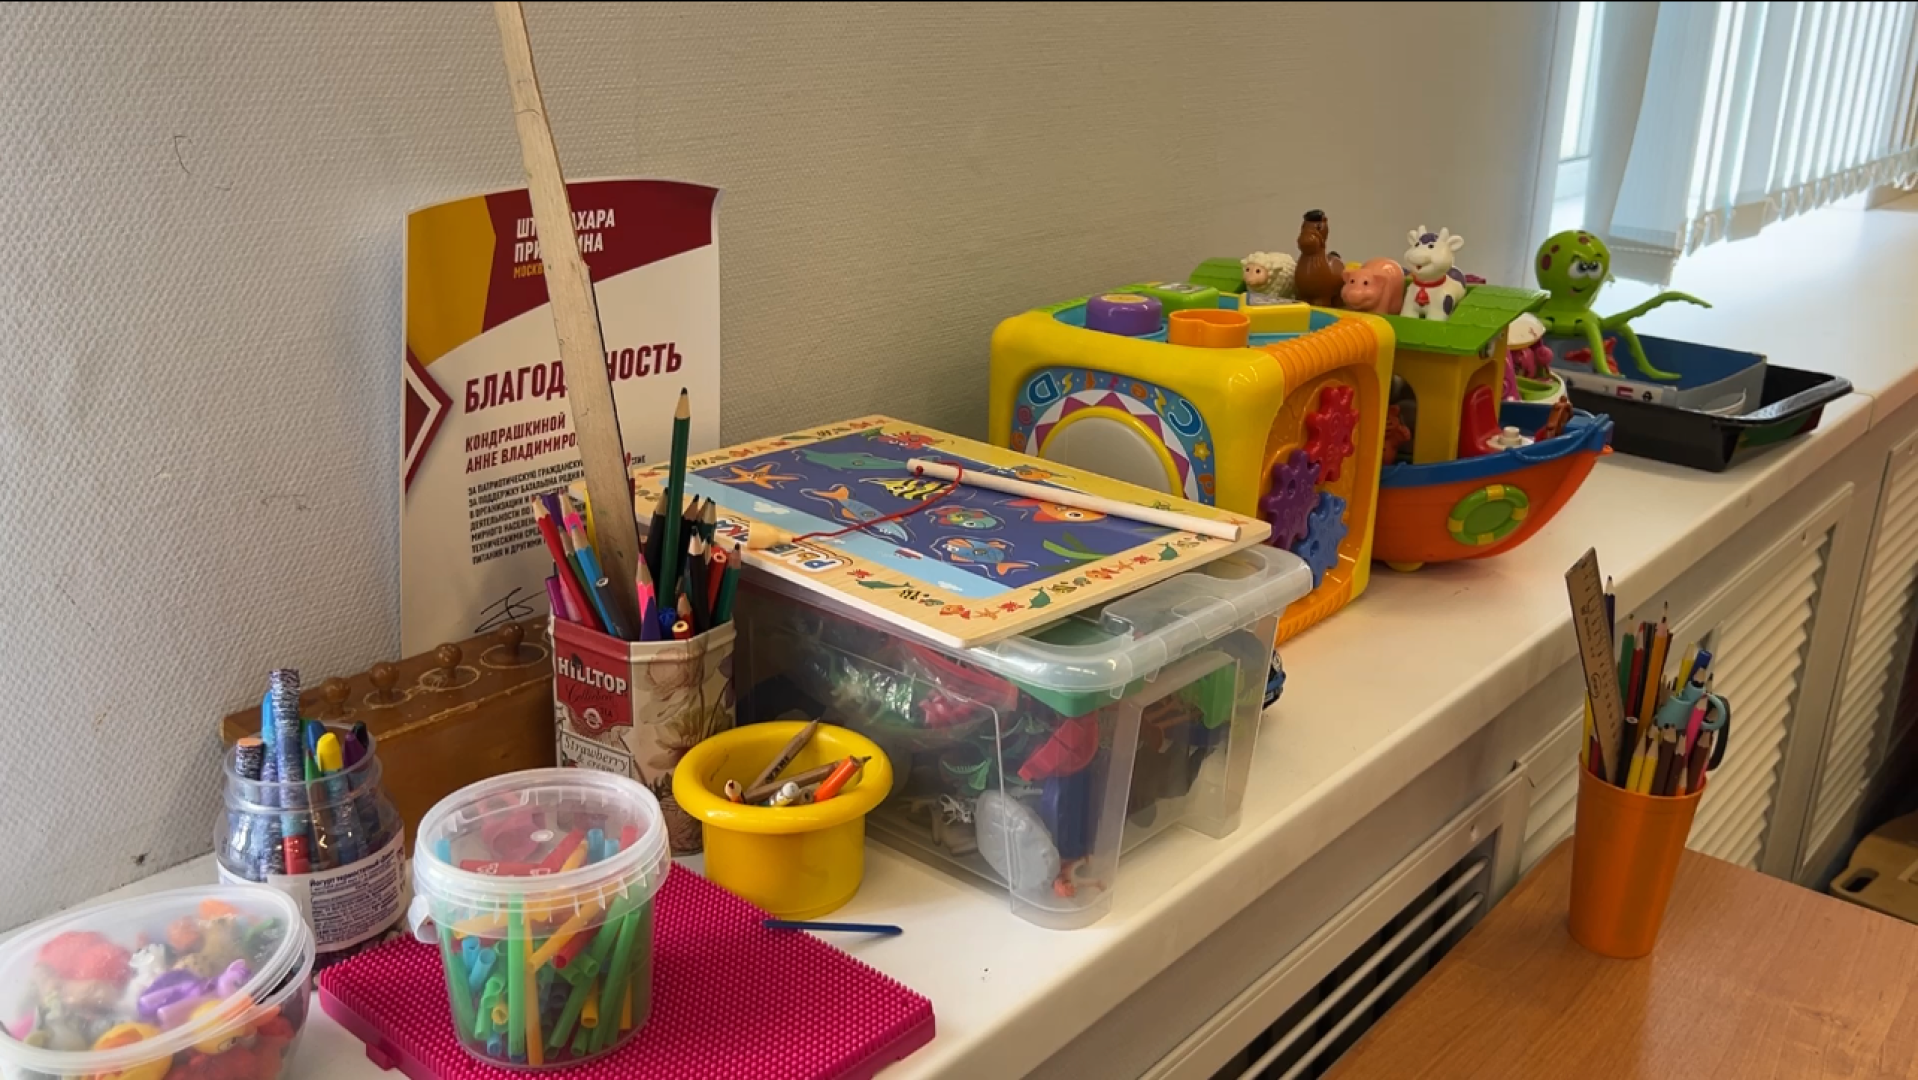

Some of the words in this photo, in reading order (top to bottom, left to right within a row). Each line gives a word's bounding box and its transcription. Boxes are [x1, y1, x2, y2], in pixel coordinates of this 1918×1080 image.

[572, 208, 615, 231] ХАРА
[514, 233, 603, 263] ПРИНА
[514, 262, 544, 279] МОСКВ
[465, 341, 682, 414] БЛАГОДНОСТЬ
[465, 411, 566, 453] КОНДРАШКИНОЙ
[465, 450, 498, 474] АННЕ
[501, 432, 578, 464] ВЛАДИМИРО
[557, 656, 628, 696] HILLTOP
[565, 736, 628, 772] Strawberry
